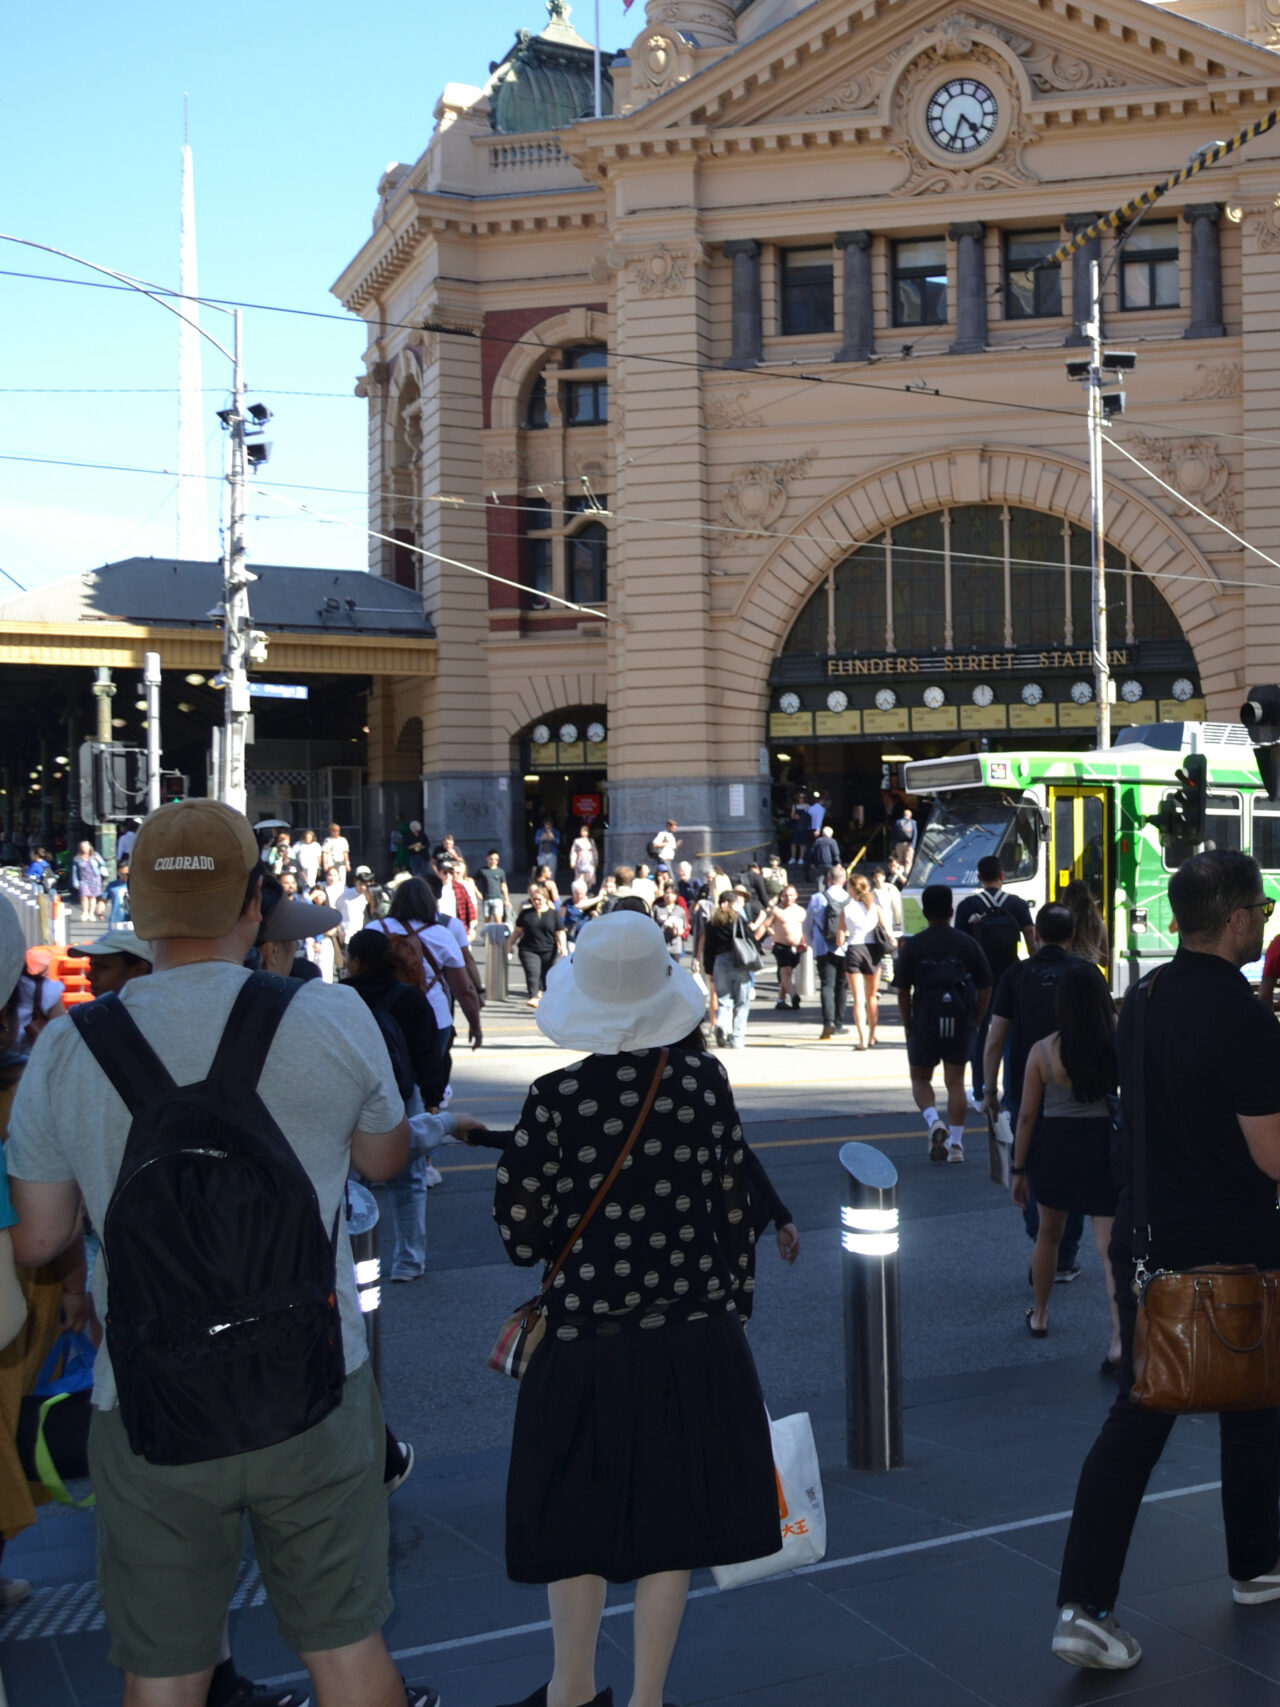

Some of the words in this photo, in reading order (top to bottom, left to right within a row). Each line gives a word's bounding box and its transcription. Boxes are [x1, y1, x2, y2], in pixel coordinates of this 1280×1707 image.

[828, 657, 920, 675] FLINDERS
[943, 653, 1015, 672] STREET
[1040, 649, 1127, 668] STATIN
[154, 855, 215, 871] COLORADO
